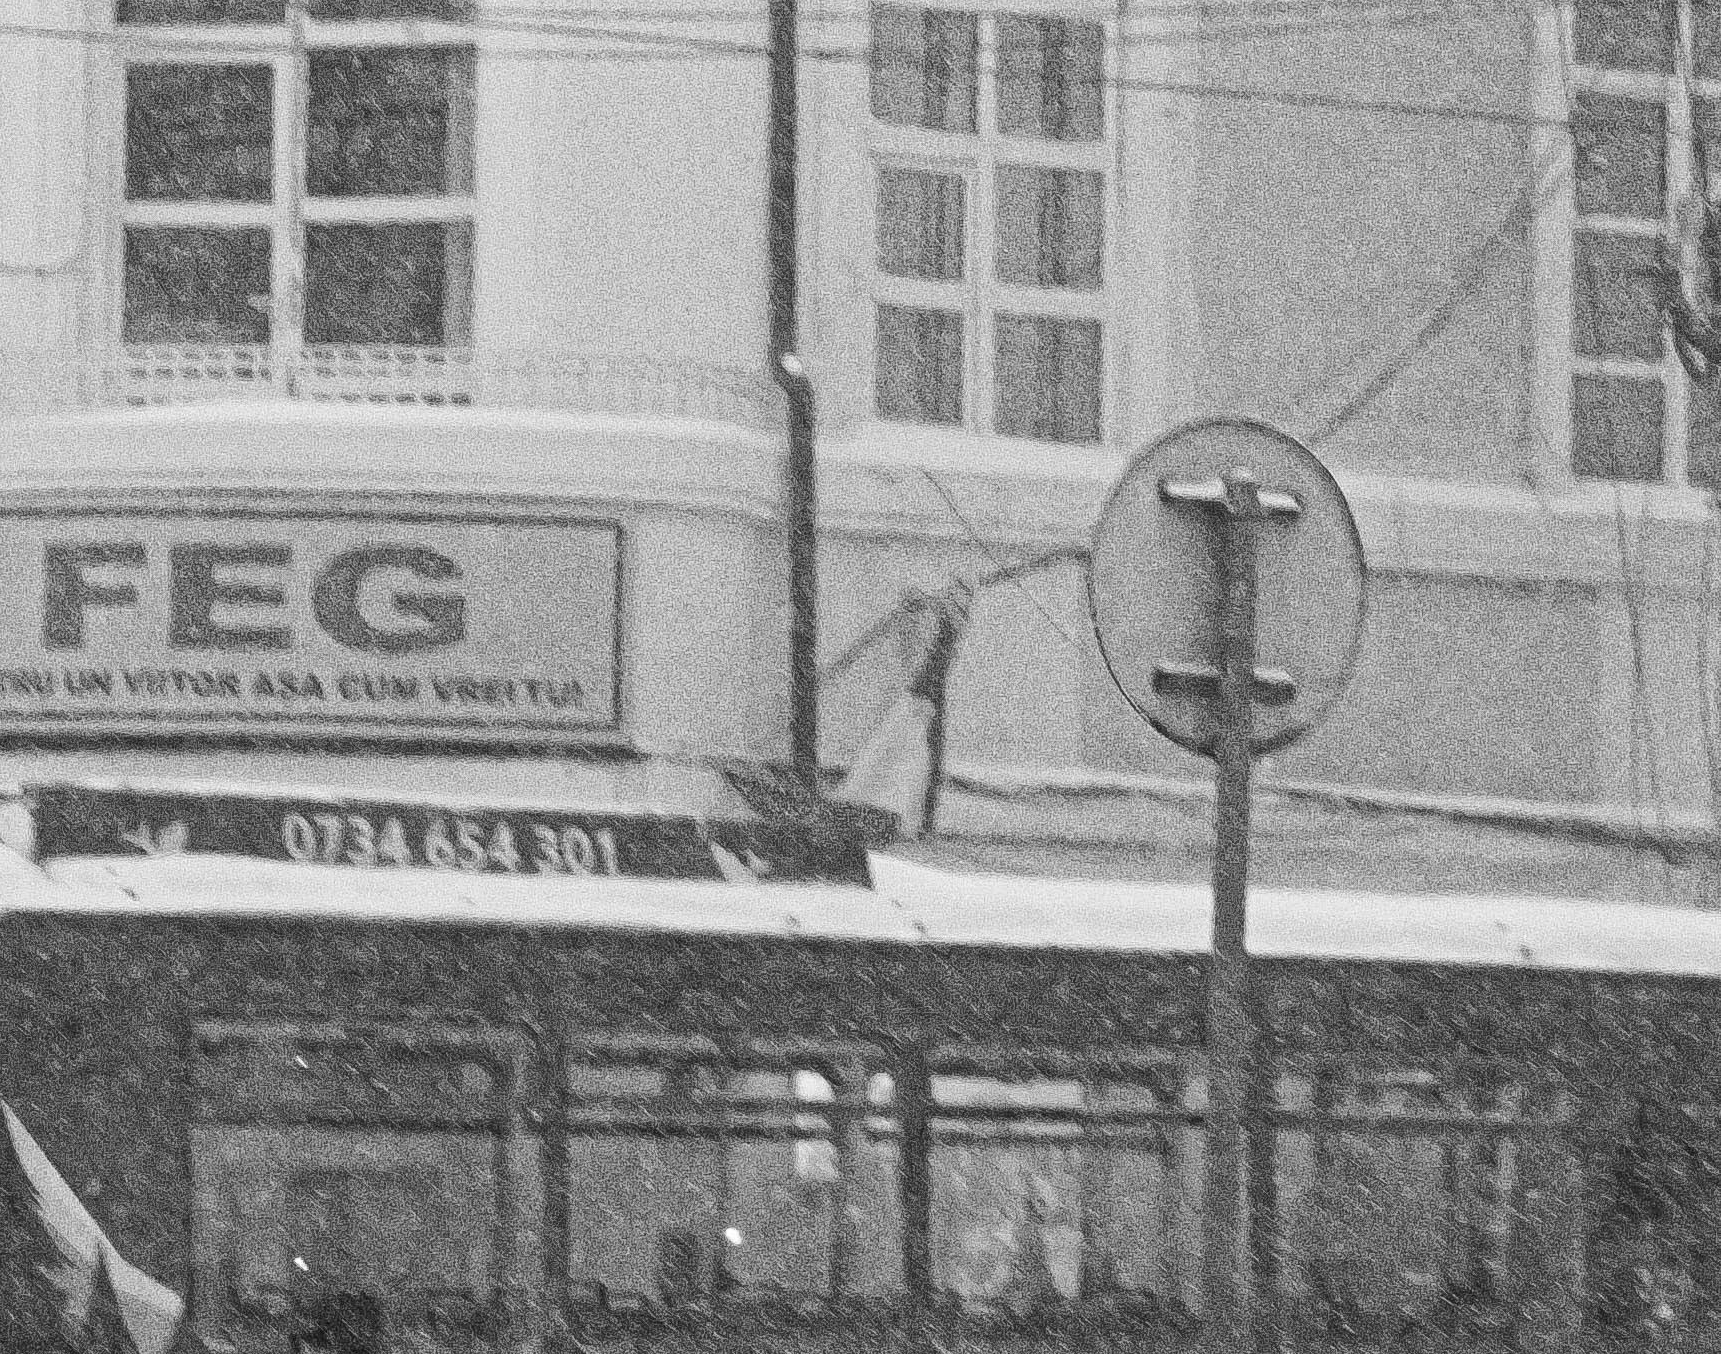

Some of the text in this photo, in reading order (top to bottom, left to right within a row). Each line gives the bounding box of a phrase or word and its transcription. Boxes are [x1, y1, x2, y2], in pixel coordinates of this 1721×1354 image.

[43, 543, 467, 654] FEG
[65, 669, 112, 698] UN
[336, 672, 419, 704] CUM
[282, 809, 619, 877] 0734 654 301
